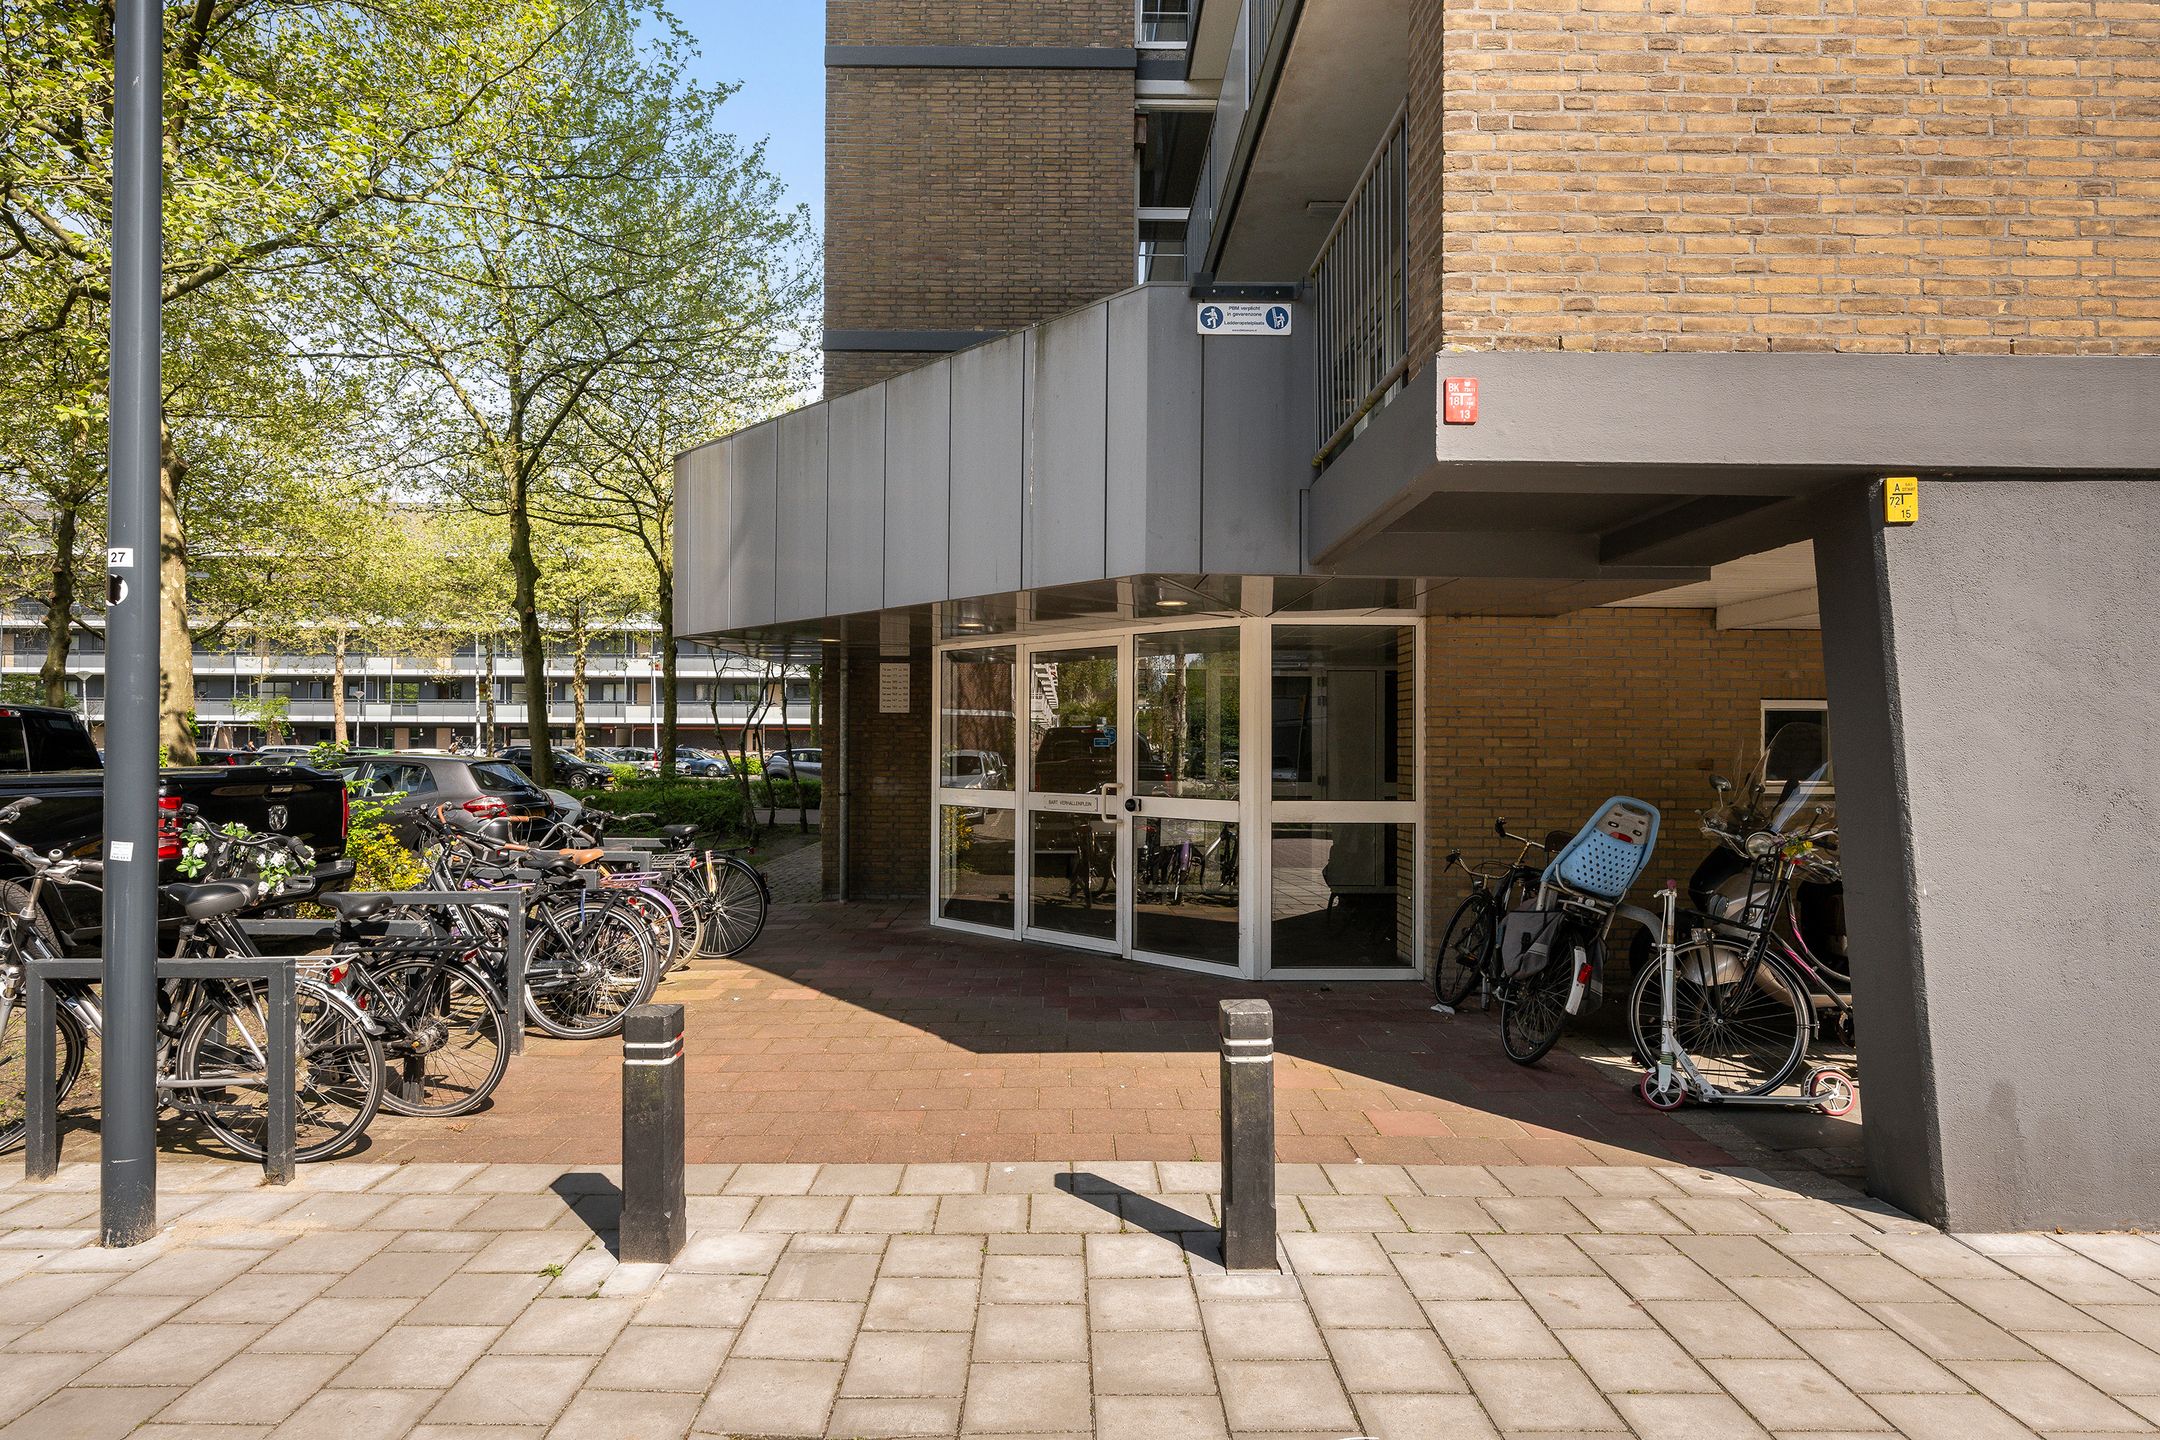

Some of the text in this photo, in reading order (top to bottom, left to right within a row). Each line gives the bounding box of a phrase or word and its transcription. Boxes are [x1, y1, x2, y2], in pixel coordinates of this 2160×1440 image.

[1448, 383, 1460, 392] BK
[1460, 410, 1471, 419] 13
[1894, 483, 1900, 492] A
[1901, 510, 1911, 518] 15
[111, 552, 126, 563] 27
